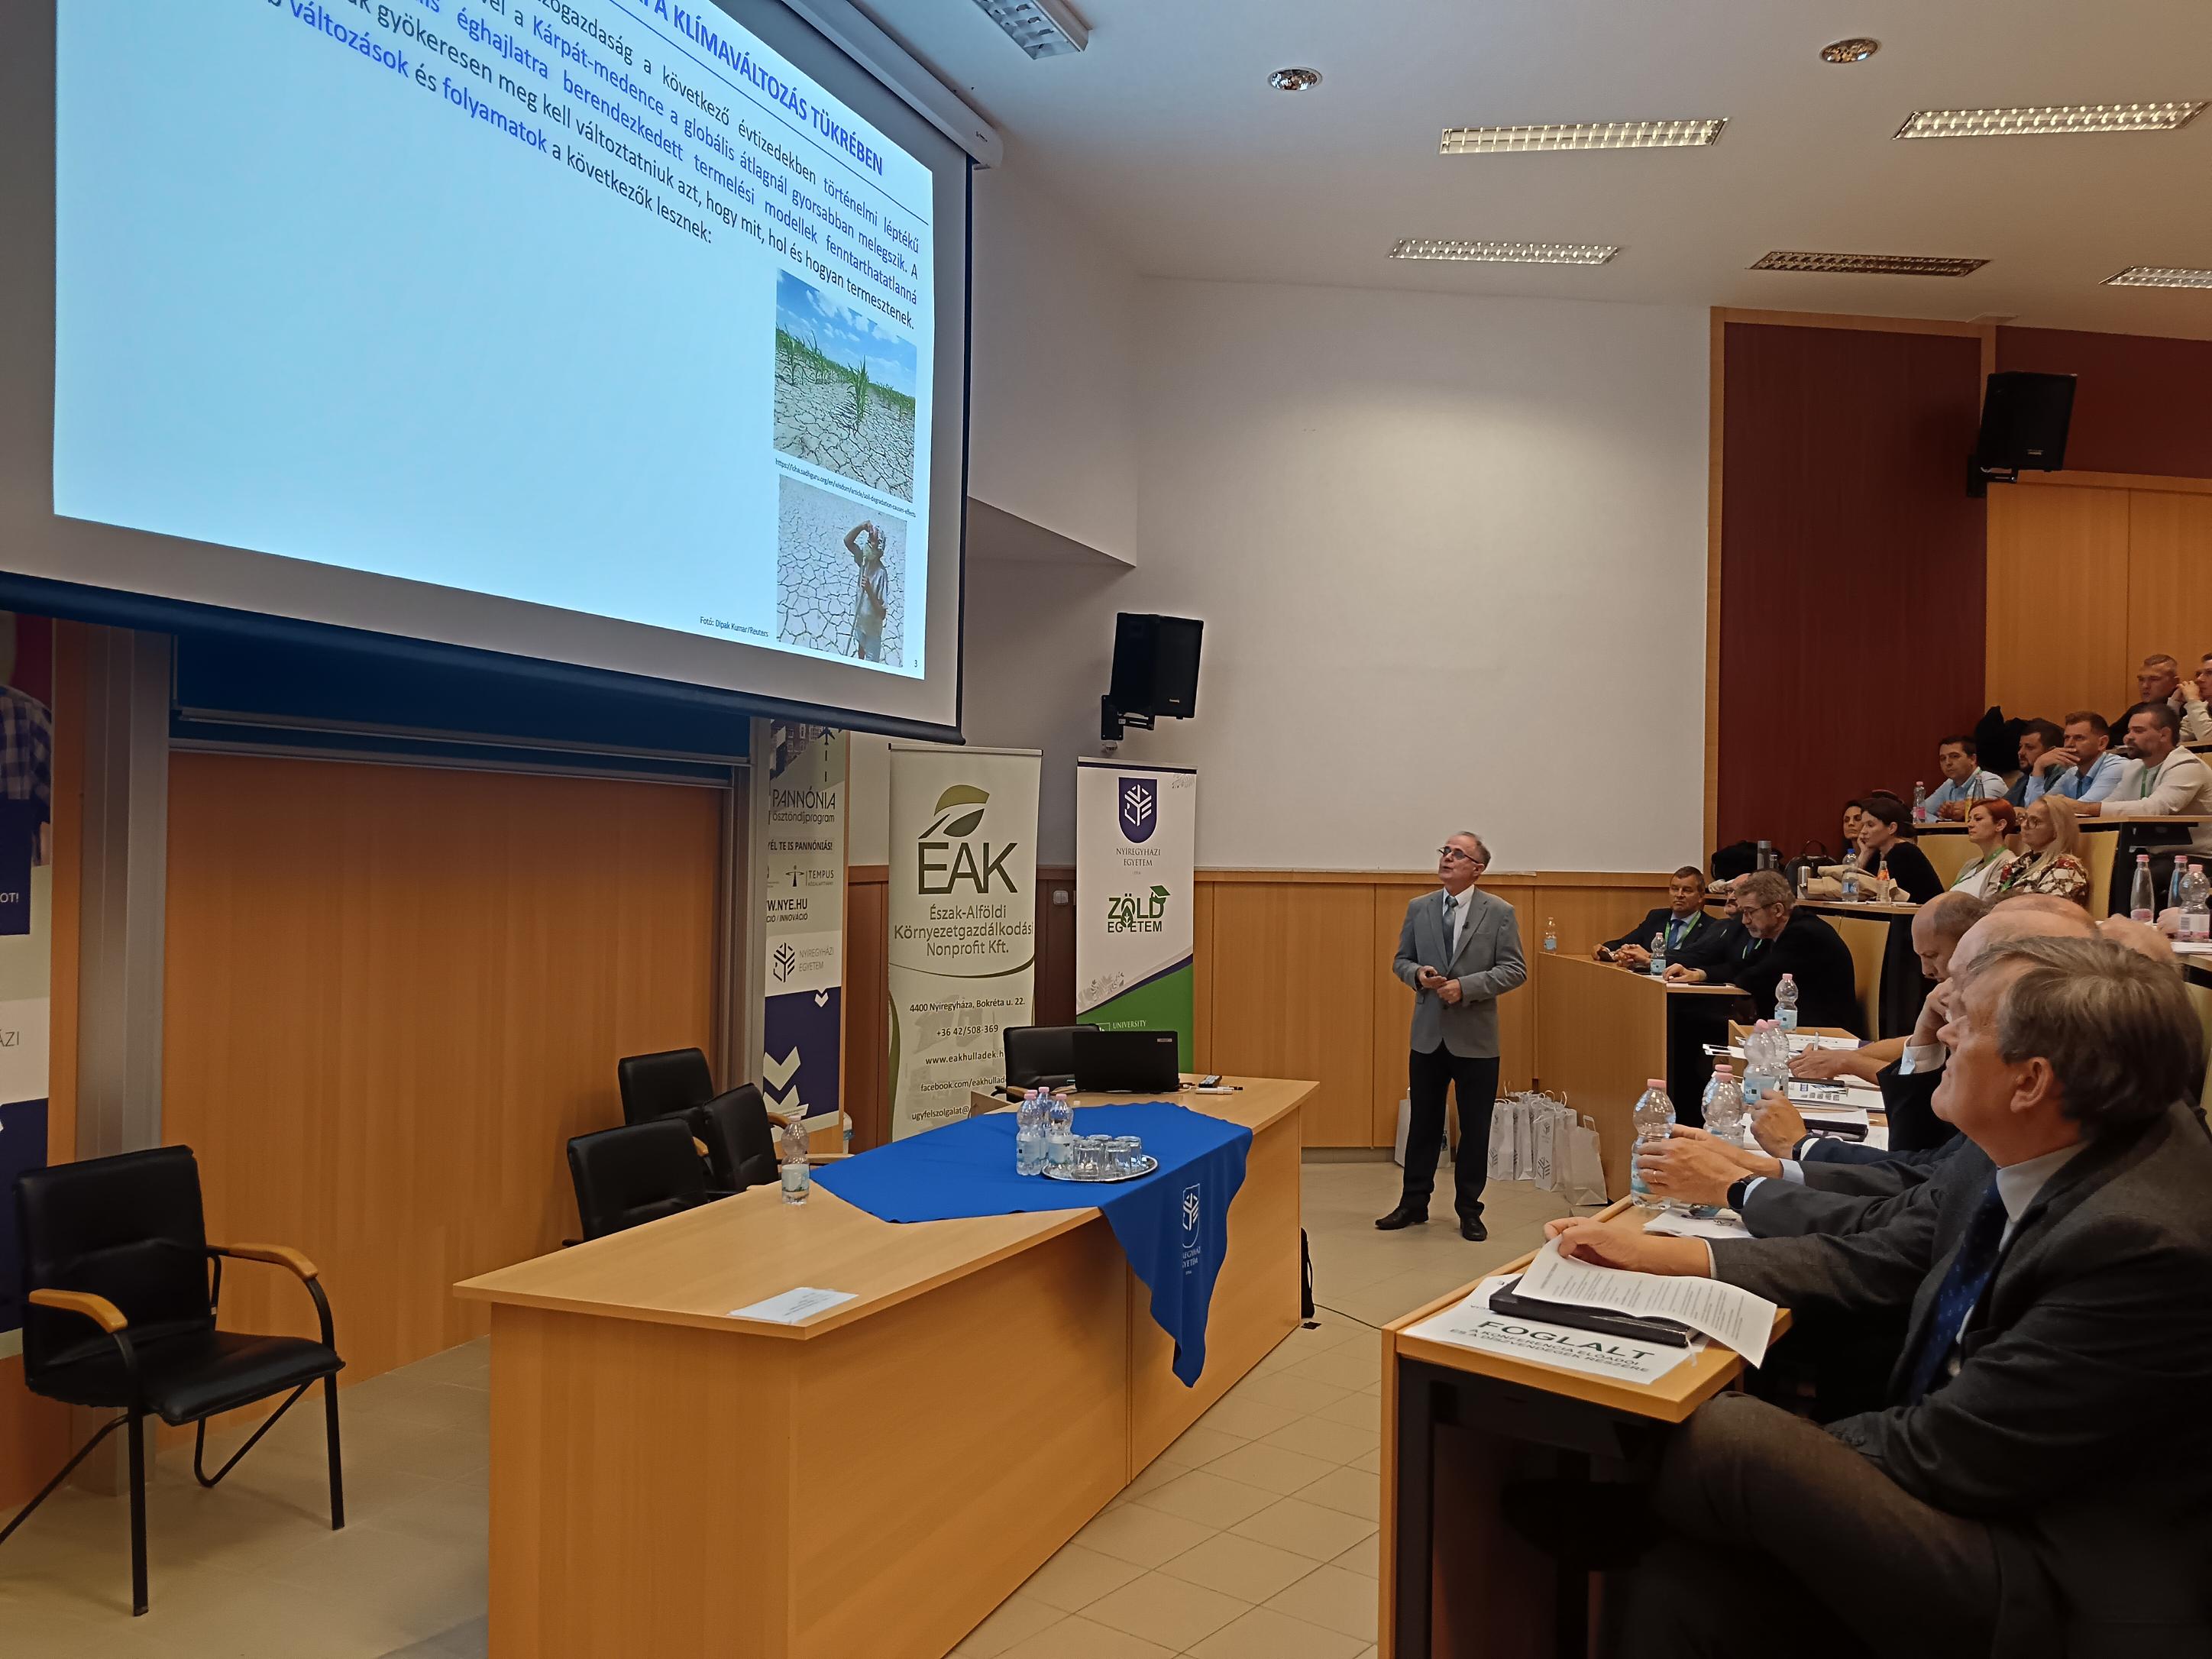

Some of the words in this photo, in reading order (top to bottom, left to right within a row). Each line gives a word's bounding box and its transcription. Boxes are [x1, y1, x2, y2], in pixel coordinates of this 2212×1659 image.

[674, 5, 807, 121] KLÍMAVÁLTOZÁS
[810, 105, 883, 176] TÜKRÉBEN
[289, 0, 409, 78] változások
[415, 63, 437, 92] és
[442, 77, 548, 154] folyamatok
[552, 144, 561, 161] a
[567, 145, 653, 212] következők
[657, 196, 712, 244] lesznek:
[514, 9, 523, 28] a
[533, 15, 665, 116] Kárpát-medence
[670, 110, 678, 126] a
[684, 118, 735, 161] globális
[739, 150, 787, 196] átlagnál
[791, 189, 854, 239] gyorsabban
[858, 231, 907, 273] melegszik.
[910, 264, 918, 280] A
[457, 7, 548, 79] éghajlatra
[563, 70, 684, 162] berendezkedett
[694, 154, 755, 205] termelési
[765, 200, 817, 244] modellek
[826, 234, 917, 306] fenntarthatatlanná
[644, 59, 652, 75] a
[662, 64, 729, 126] következő
[738, 119, 817, 185] évtizedekben
[823, 177, 878, 227] történelmi
[884, 216, 919, 254] léptékű
[377, 5, 492, 83] gyökeresen
[499, 74, 538, 113] meg
[543, 93, 571, 128] kell
[576, 118, 674, 189] változtatniuk
[678, 180, 702, 207] azt,
[706, 190, 738, 228] hogy
[741, 216, 765, 244] mit,
[768, 228, 787, 254] hol
[790, 243, 802, 263] és
[806, 251, 844, 289] hogyan
[847, 277, 914, 330] termesztenek.
[700, 616, 714, 626] Fotó:
[715, 619, 730, 629] Dipak
[731, 623, 769, 637] Kumar/Reuters
[914, 659, 918, 668] 3
[772, 785, 836, 810] PANNÓNIA
[779, 842, 787, 851] TE
[787, 842, 794, 851] IS
[794, 839, 833, 851] PANNÓNIÁS!
[918, 842, 1018, 895] EAK
[1124, 858, 1153, 866] EGYETEM
[808, 869, 834, 879] TEMPUS
[0, 892, 19, 903] OT!
[1108, 892, 1166, 920] ZÖLD
[930, 904, 1007, 920] Észak-Alföldi
[894, 921, 1034, 942] Környezetgazdálkodási
[927, 940, 985, 959] Nonprofit
[988, 939, 1009, 953] Kft.
[909, 1003, 928, 1012] 4400
[930, 1000, 975, 1012] Nyíregyháza,
[976, 998, 1004, 1007] Bokréta
[1014, 997, 1025, 1006] 22.
[936, 1028, 951, 1036] +36
[953, 1024, 999, 1036] 42/508-369
[1113, 1020, 1147, 1030] UNIVERSITY
[925, 1050, 1004, 1065] www.eakhulladek.h
[1478, 1320, 1656, 1360] FOGLALT
